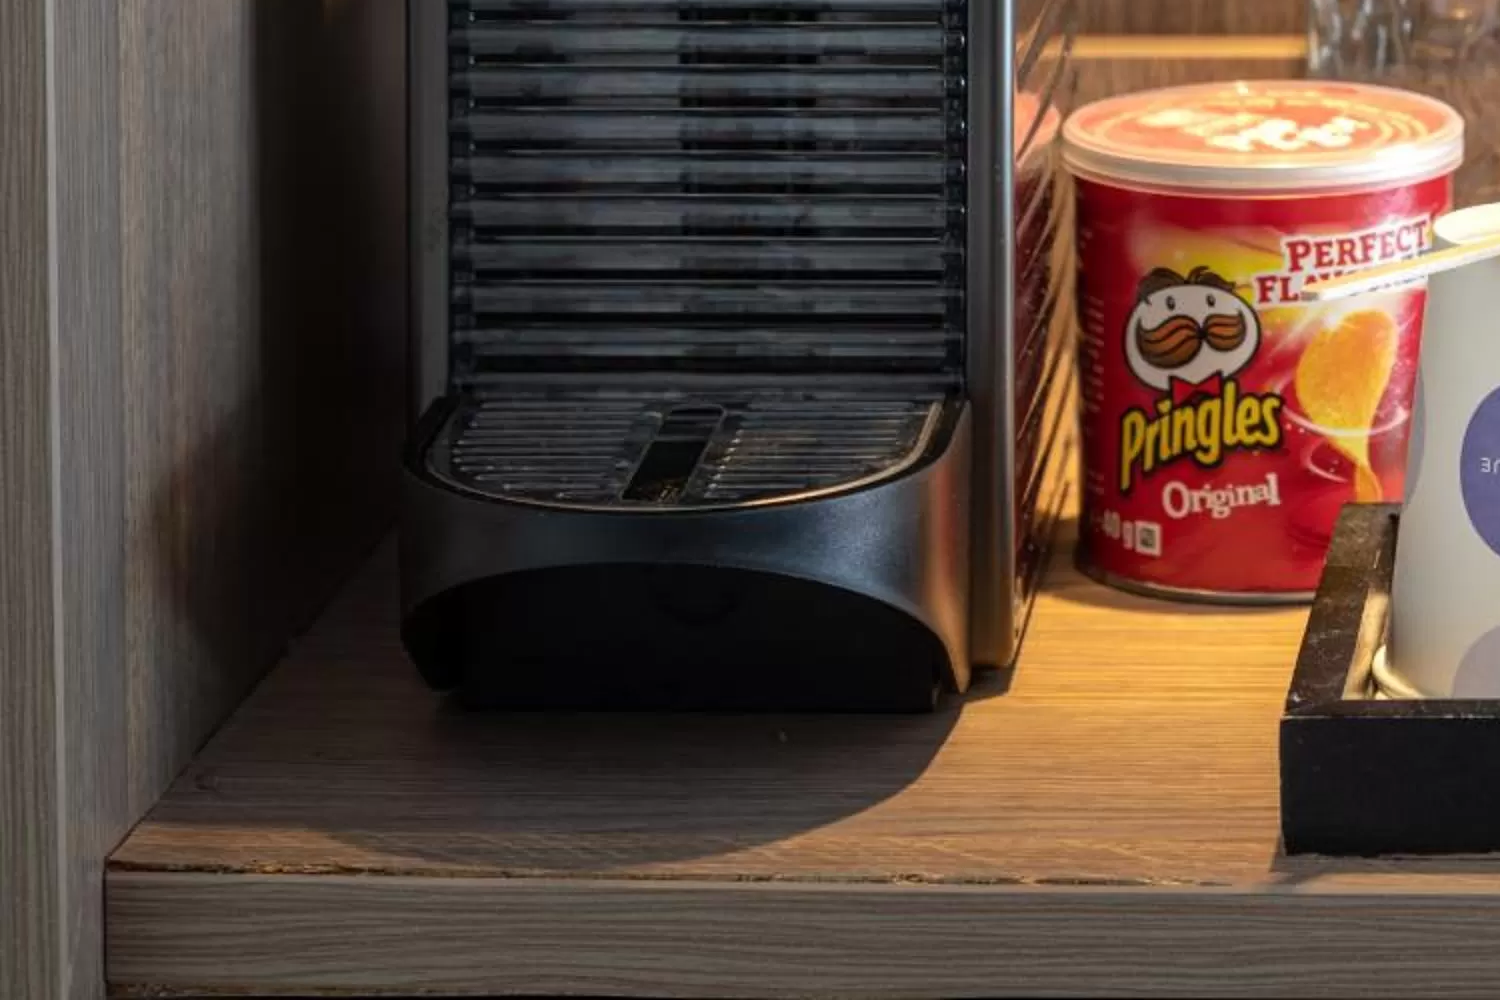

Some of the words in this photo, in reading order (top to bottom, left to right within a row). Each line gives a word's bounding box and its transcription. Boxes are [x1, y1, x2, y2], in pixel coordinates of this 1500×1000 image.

[1286, 219, 1428, 273] PERFECT
[1119, 381, 1283, 496] Pringles
[1161, 471, 1282, 520] Original
